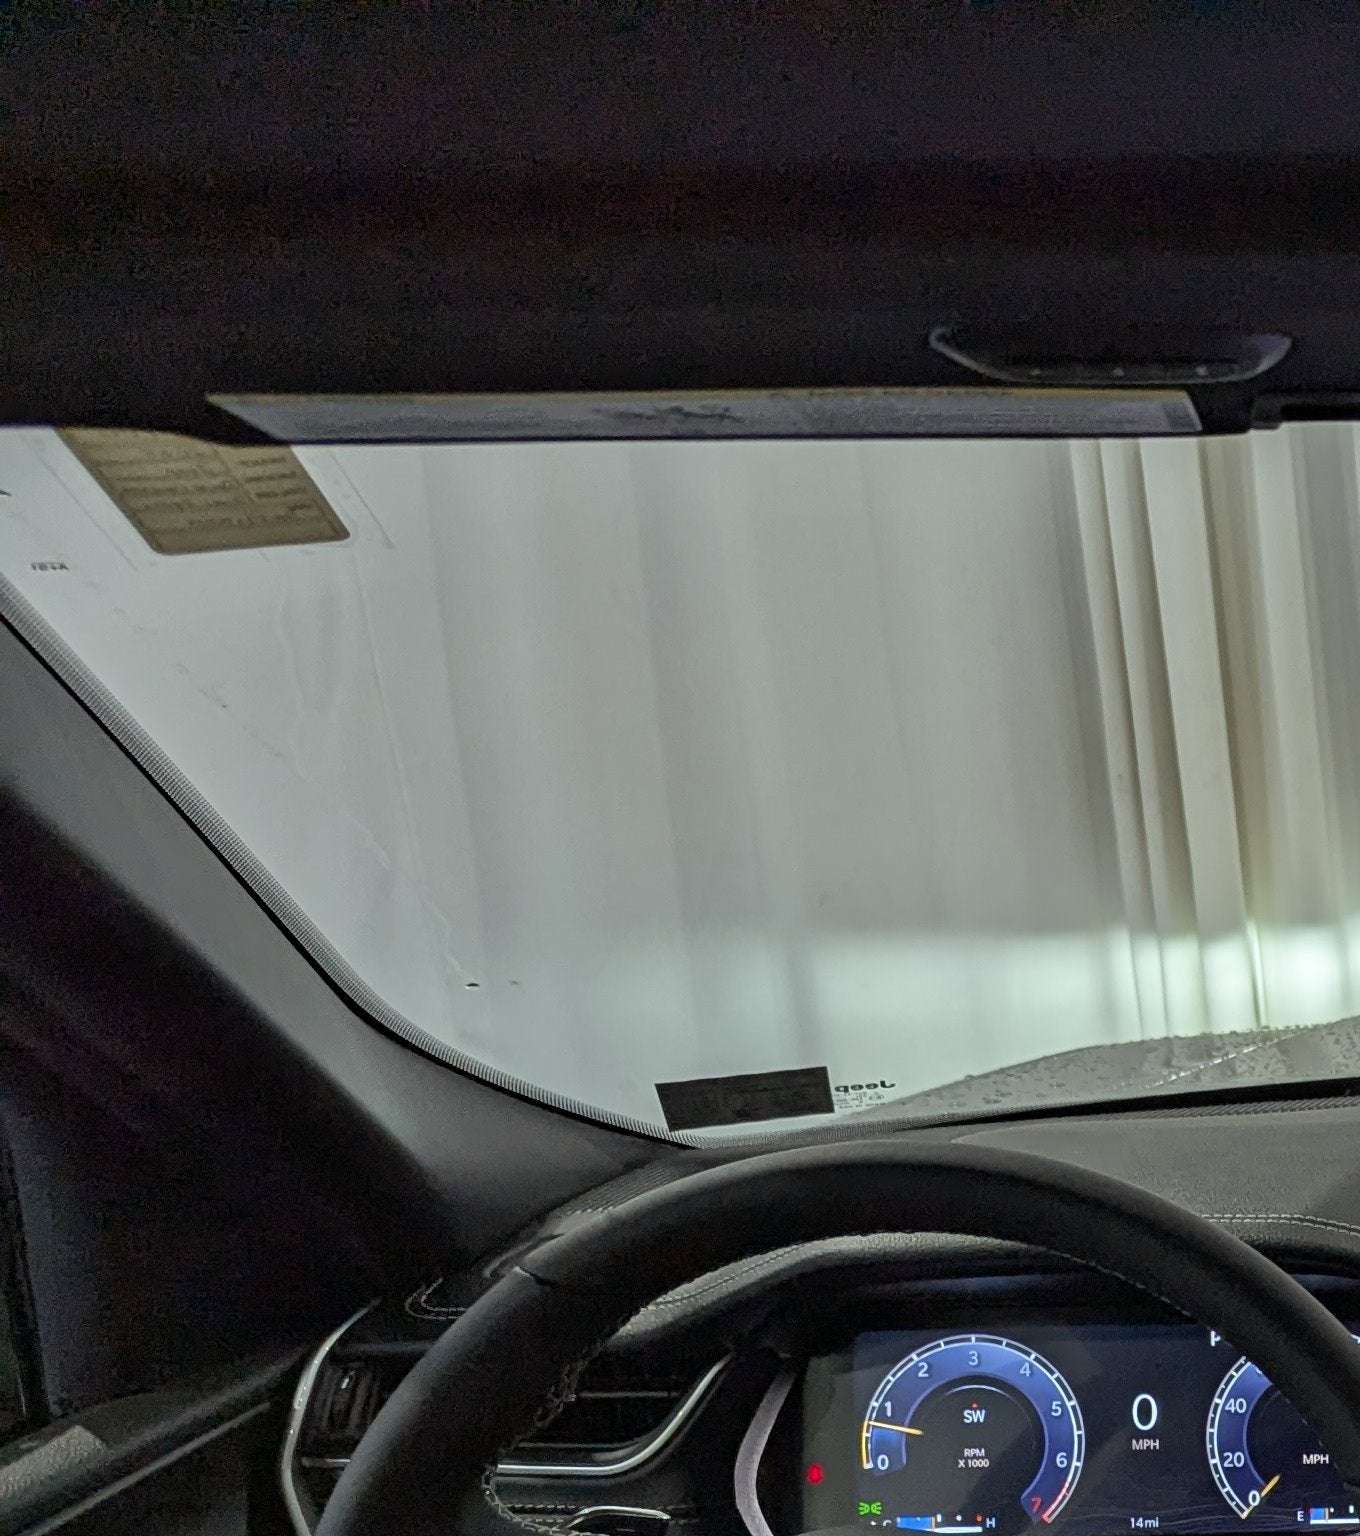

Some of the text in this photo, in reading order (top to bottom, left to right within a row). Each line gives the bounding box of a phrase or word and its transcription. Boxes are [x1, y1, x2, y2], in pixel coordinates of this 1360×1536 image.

[968, 1351, 979, 1366] 3
[917, 1362, 929, 1378] 2
[1020, 1362, 1031, 1377] 4
[885, 1401, 892, 1417] 1
[1051, 1401, 1062, 1417] 5
[1132, 1393, 1158, 1431] 0
[1224, 1397, 1247, 1414] 40
[963, 1409, 986, 1424] SW
[1131, 1438, 1160, 1451] MPH
[964, 1448, 985, 1457] RPM
[1056, 1451, 1067, 1468] 6
[1223, 1452, 1245, 1468] 20
[1302, 1454, 1329, 1466] MPH
[877, 1454, 889, 1470] 0
[958, 1458, 989, 1468] X 1000
[1031, 1498, 1041, 1513] 7
[1248, 1490, 1260, 1507] 0
[986, 1518, 996, 1528] H
[1297, 1511, 1304, 1522] E
